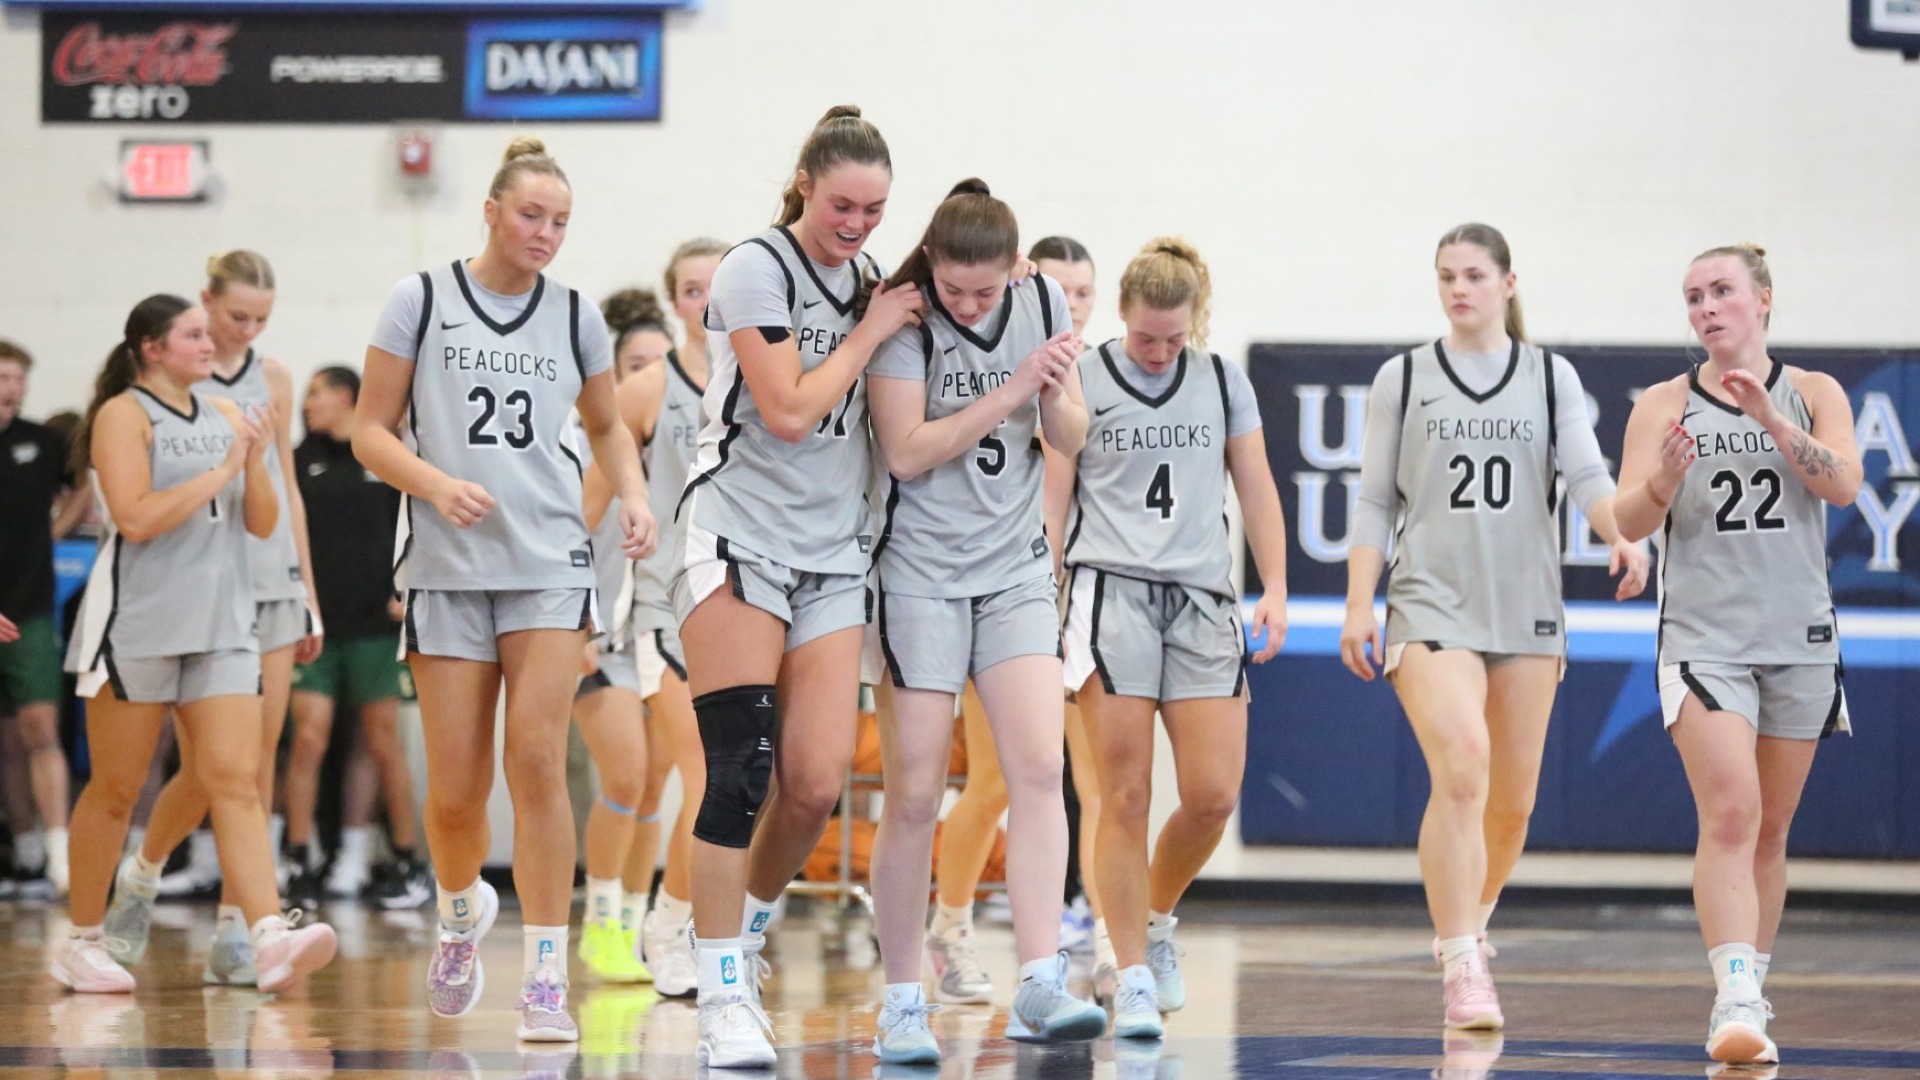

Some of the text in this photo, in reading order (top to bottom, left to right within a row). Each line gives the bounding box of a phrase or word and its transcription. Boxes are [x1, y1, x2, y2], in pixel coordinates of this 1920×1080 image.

[485, 42, 639, 94] DASANI
[90, 84, 190, 118] zero
[444, 346, 557, 382] PEACOCKS
[941, 370, 1017, 398] PEACO
[467, 385, 536, 451] 23
[1102, 424, 1211, 453] PEACOCKS
[1427, 418, 1534, 441] PEACOCKS
[976, 419, 1006, 479] 5
[1685, 430, 1781, 460] EACOC
[1145, 461, 1176, 522] 4
[1448, 453, 1513, 513] 20
[1709, 467, 1788, 534] 22
